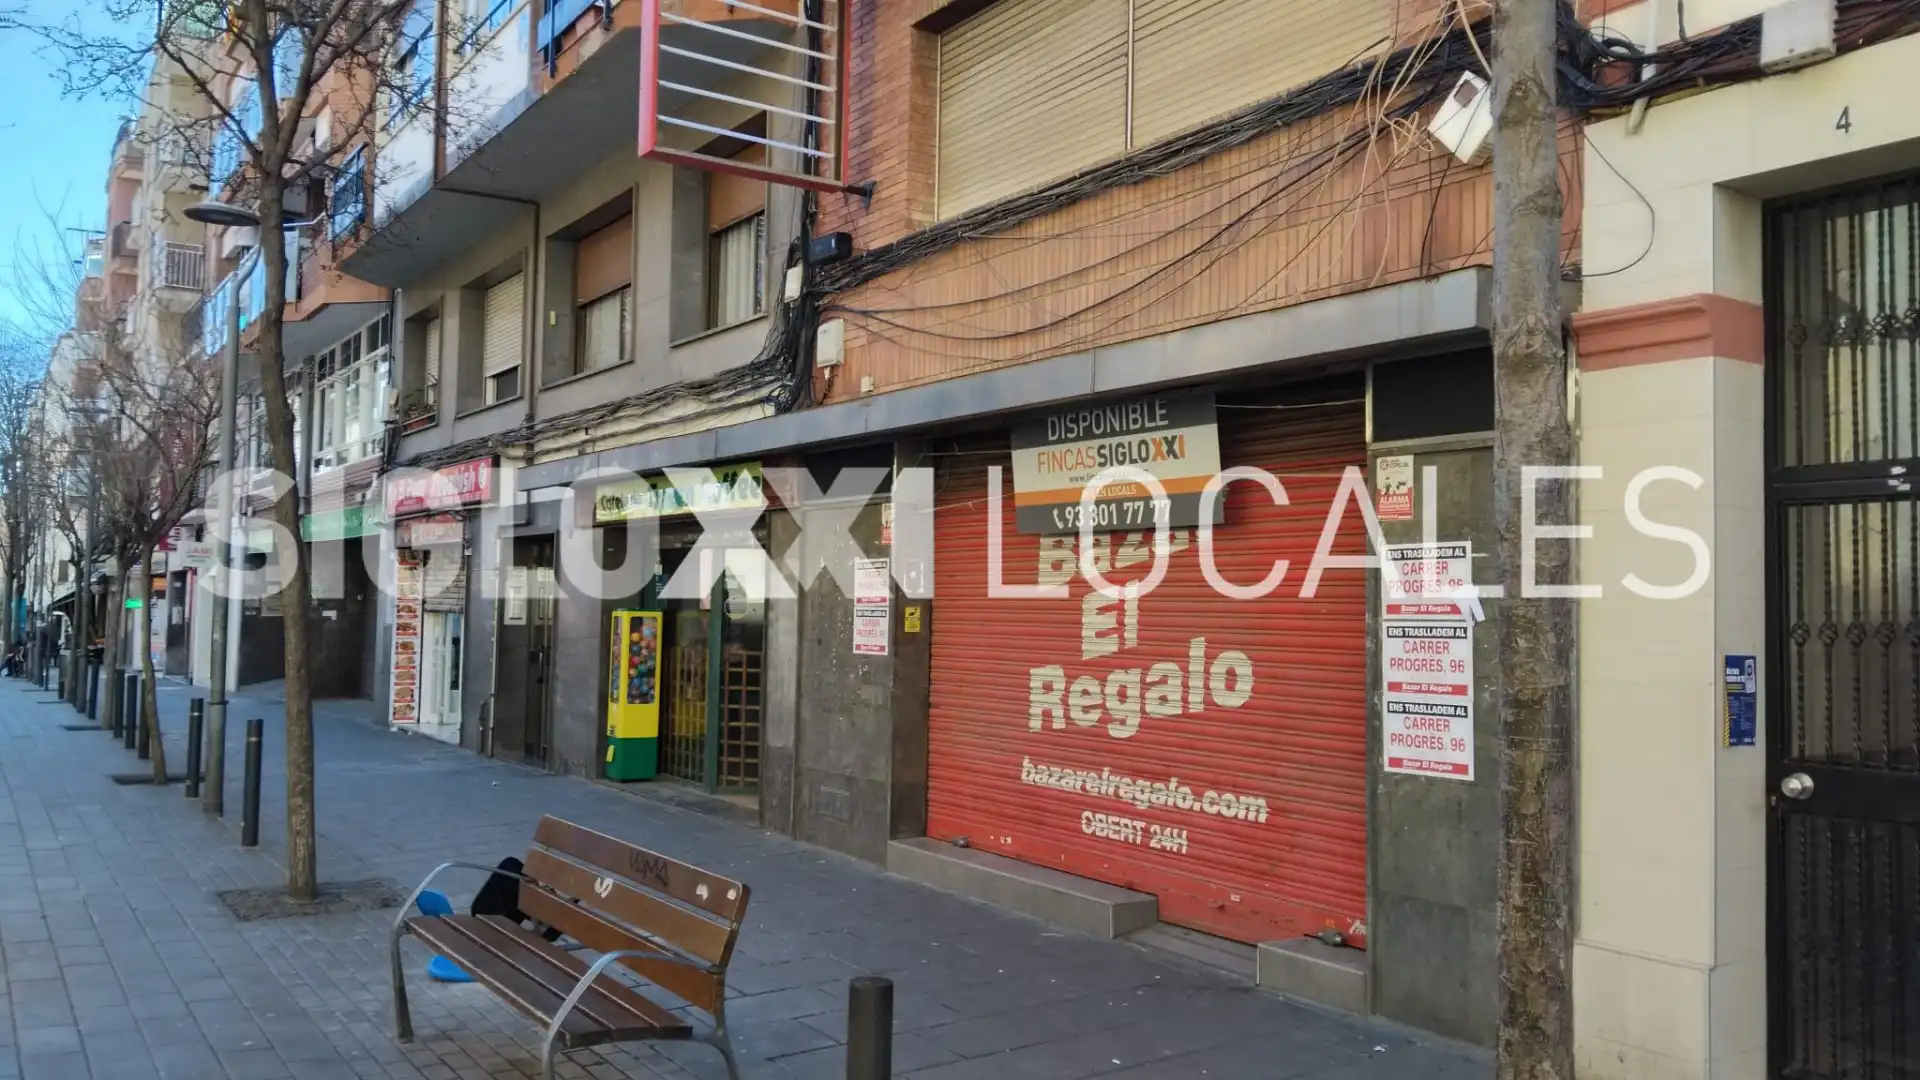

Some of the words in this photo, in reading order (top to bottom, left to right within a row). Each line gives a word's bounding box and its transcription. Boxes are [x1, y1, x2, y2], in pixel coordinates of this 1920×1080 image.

[1835, 106, 1852, 134] 4
[1047, 400, 1170, 442] DISPONIBLE
[1380, 495, 1409, 504] ALARMA
[1065, 505, 1084, 528] 93
[1088, 502, 1117, 527] 301
[1124, 500, 1144, 524] 77
[1151, 497, 1172, 523] 77
[1387, 549, 1404, 560] ENS
[1454, 547, 1465, 557] AL
[1402, 561, 1449, 577] CARRER
[1081, 579, 1139, 660] El
[1388, 627, 1404, 637] ENS
[1404, 627, 1455, 638] TRASLLADEM
[1455, 628, 1466, 638] AL
[1402, 640, 1450, 655] CARRER
[1449, 659, 1465, 674] 96
[1028, 636, 1255, 738] Regalo
[1388, 702, 1404, 712] ENS
[1404, 703, 1455, 715] TRASLLADEM
[1455, 706, 1467, 716] AL
[1403, 716, 1451, 733] CARRER
[1450, 737, 1466, 752] 96
[1020, 755, 1271, 824] bazarelregalo.com
[1081, 811, 1147, 845] OBERT
